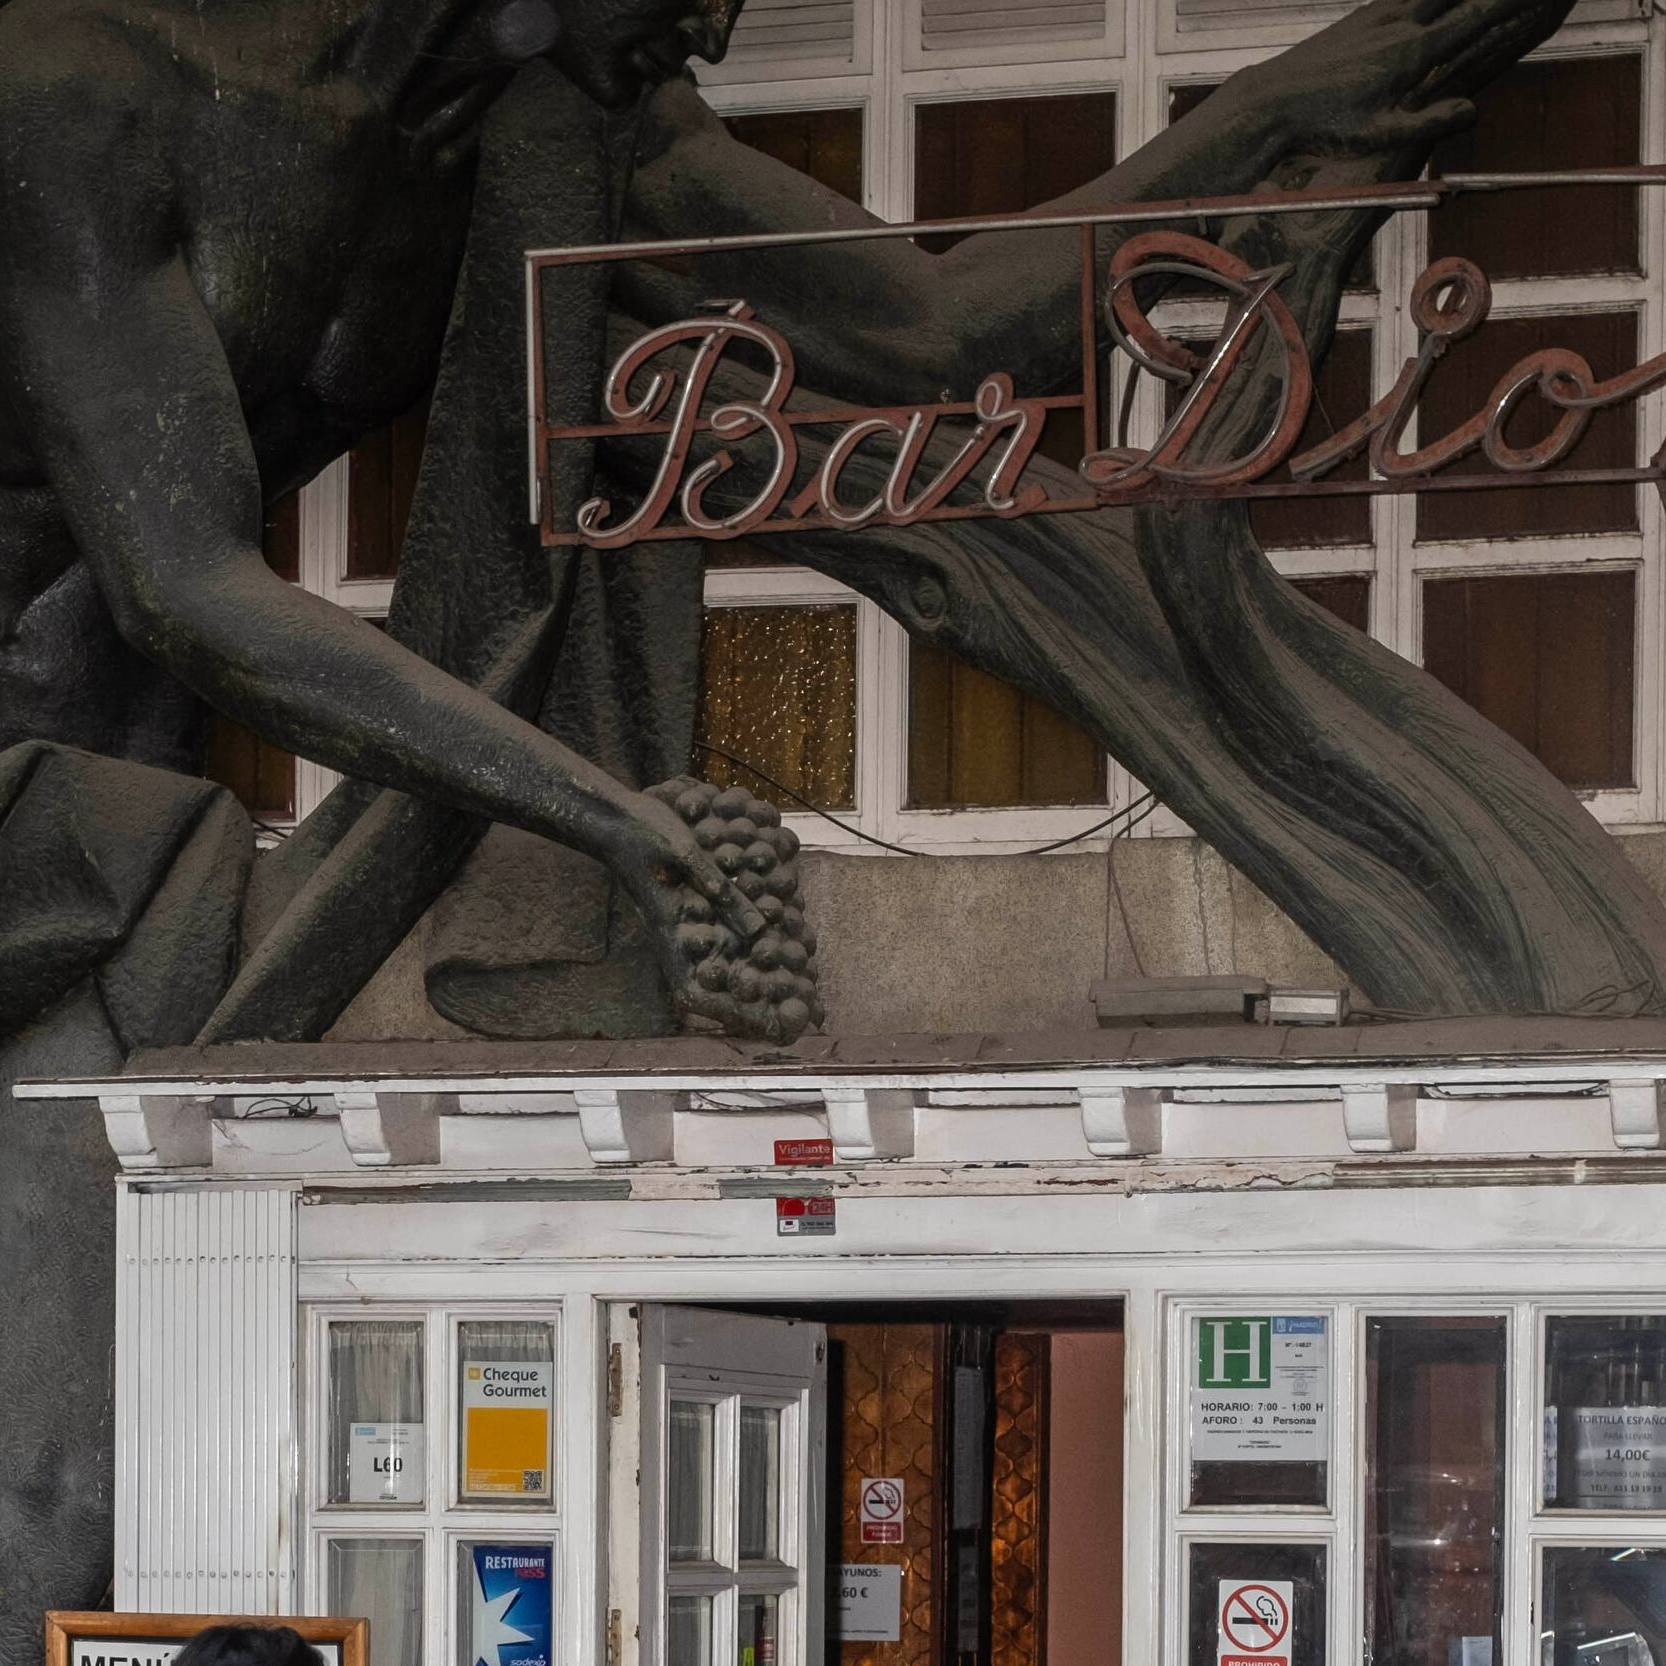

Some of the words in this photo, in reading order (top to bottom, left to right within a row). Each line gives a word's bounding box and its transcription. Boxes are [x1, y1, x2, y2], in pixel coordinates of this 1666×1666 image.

[576, 300, 1048, 548] Bar
[778, 1144, 830, 1157] Vigilante
[1206, 1321, 1267, 1382] H
[483, 1368, 539, 1383] Cheque
[483, 1384, 547, 1397] Gourmet
[1201, 1403, 1253, 1412] HORARIO:
[1258, 1403, 1278, 1412] 7:00
[1292, 1403, 1311, 1412] 1:00
[1316, 1403, 1324, 1412] H
[1202, 1416, 1237, 1425] AFORO
[1252, 1416, 1264, 1425] 43
[1273, 1416, 1317, 1425] Personas
[1577, 1415, 1623, 1424] TORTILLA
[1604, 1449, 1651, 1462] 14,00€
[373, 1457, 403, 1472] L60
[485, 1556, 545, 1569] RESTAURANTE
[509, 1656, 546, 1666] sodexo
